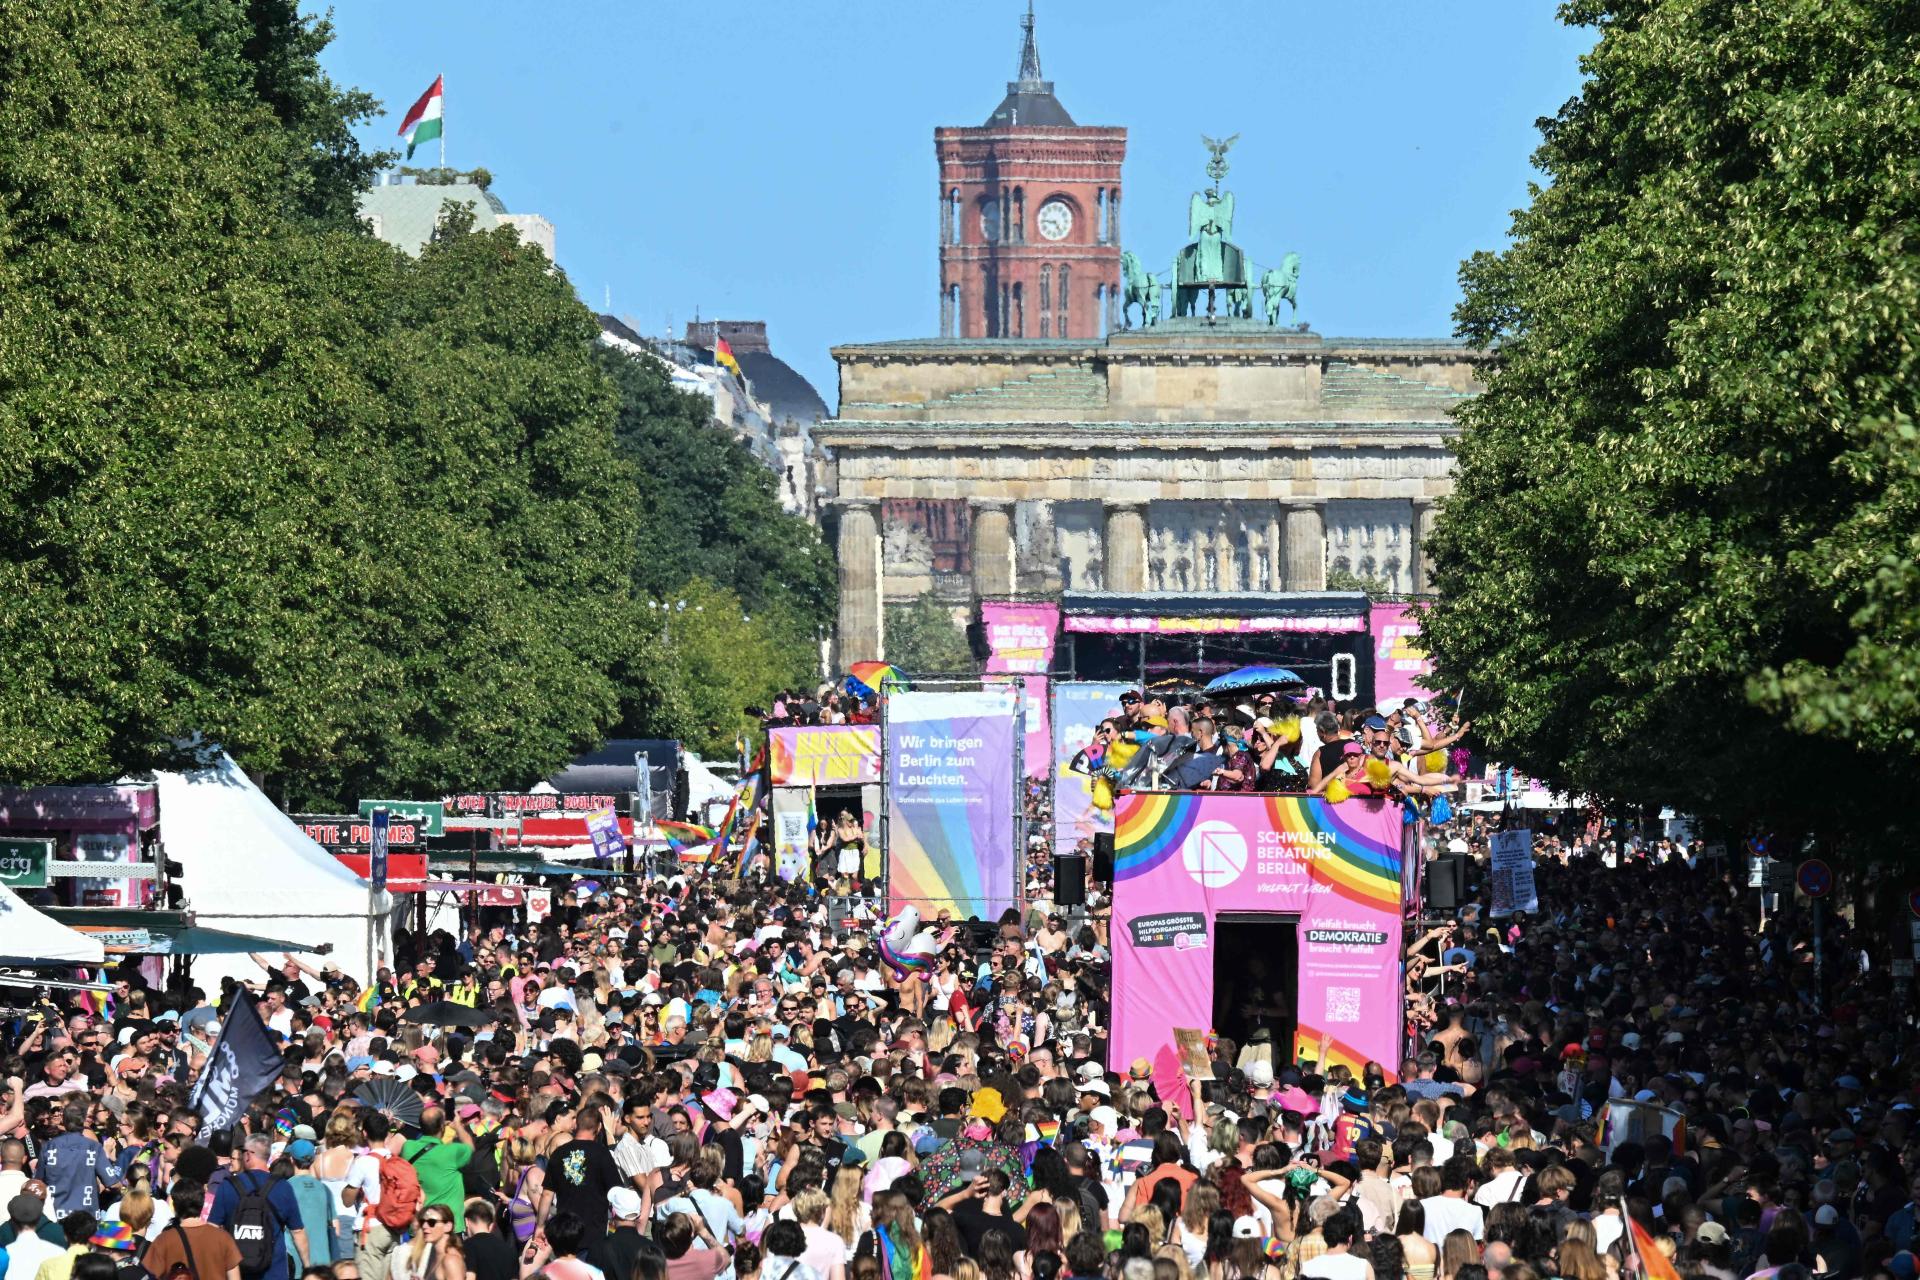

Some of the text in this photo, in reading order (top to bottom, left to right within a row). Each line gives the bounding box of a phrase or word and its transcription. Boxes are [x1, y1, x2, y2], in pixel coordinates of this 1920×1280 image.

[899, 735, 983, 752] Wir bringen
[900, 754, 975, 767] Berlin zum
[899, 772, 968, 785] Leuchten.
[301, 825, 415, 843] ETTE POMES
[1257, 831, 1336, 844] SCHWULEN
[1257, 847, 1331, 860] BERATUNG
[1257, 862, 1307, 875] BERLIN
[1137, 919, 1166, 928] EUROPAS
[1138, 923, 1202, 935] HILFSORGANISATION
[1311, 918, 1376, 930] Vielfalt braucht
[1310, 931, 1382, 943] DEMOKRATIE
[1309, 943, 1374, 954] braucht Vielfalt
[1346, 1126, 1361, 1142] 19
